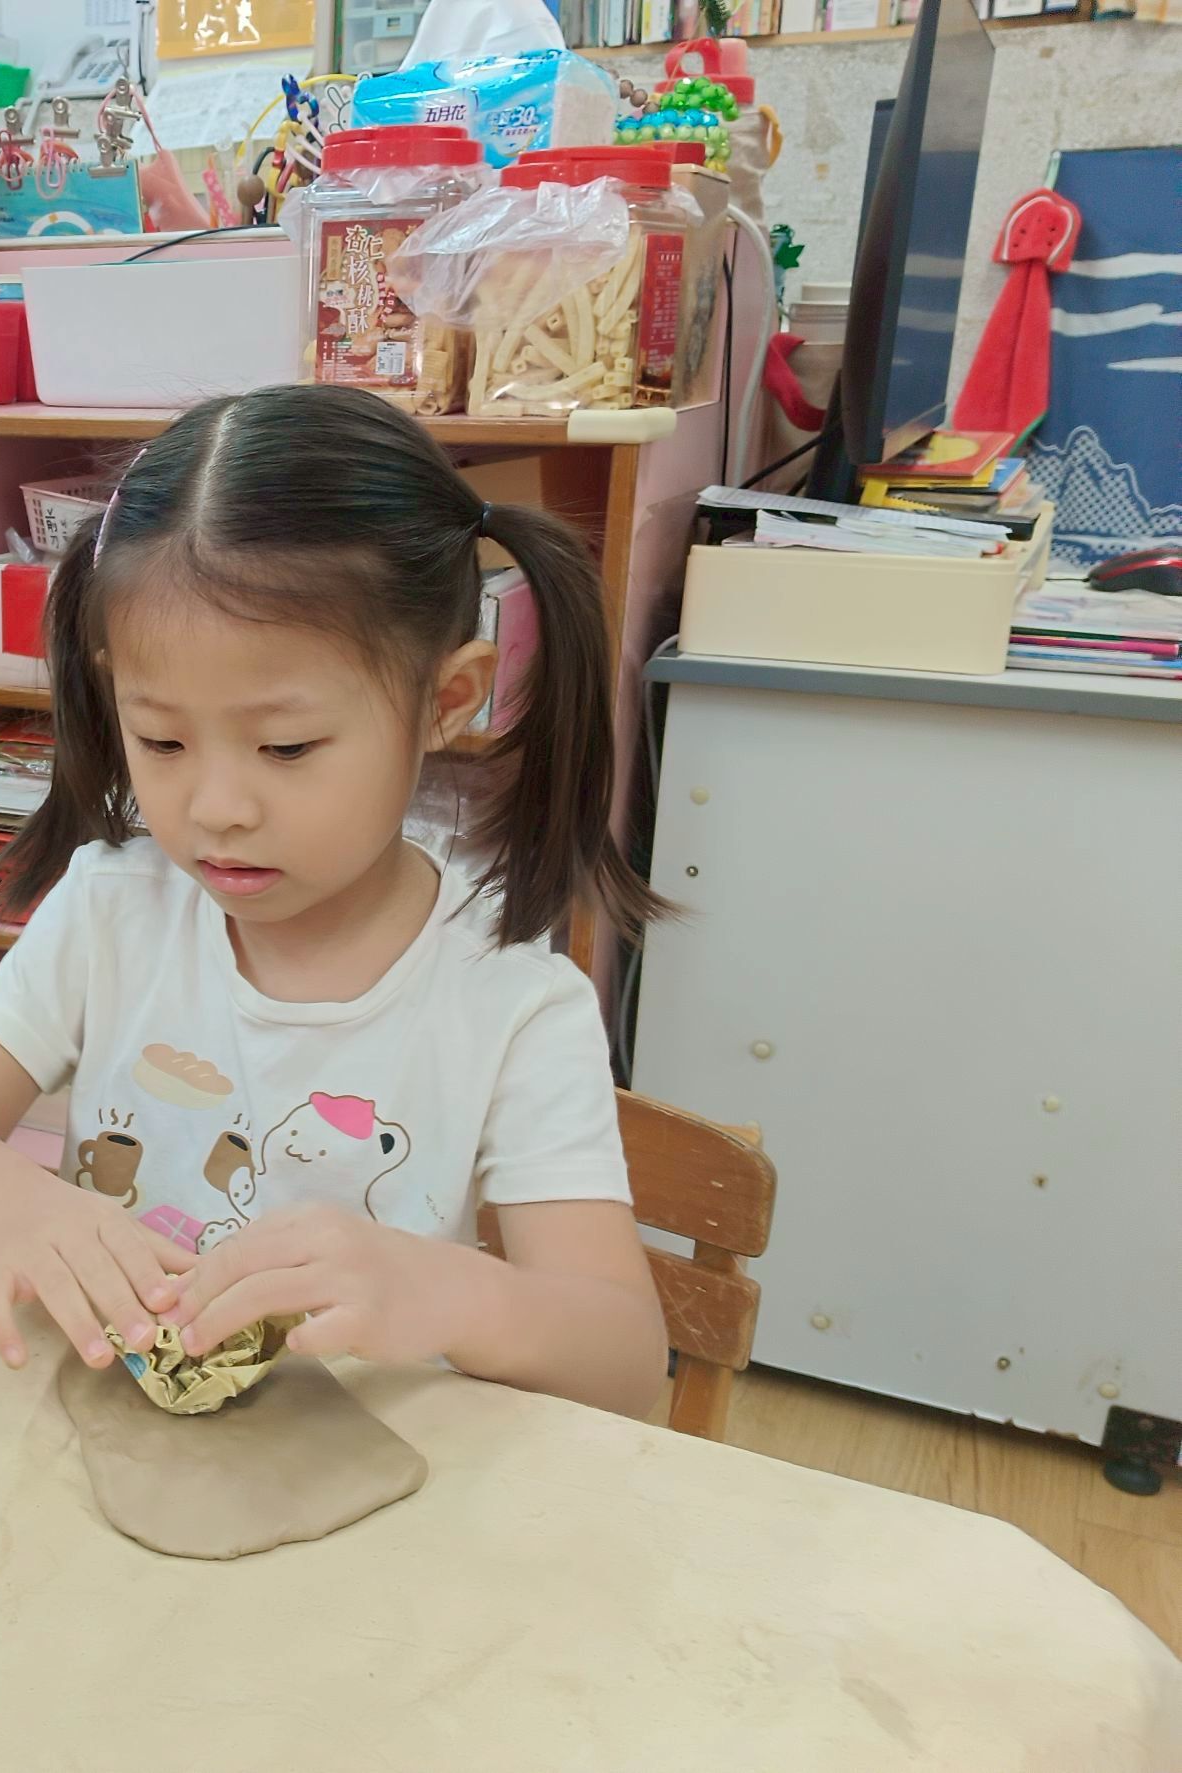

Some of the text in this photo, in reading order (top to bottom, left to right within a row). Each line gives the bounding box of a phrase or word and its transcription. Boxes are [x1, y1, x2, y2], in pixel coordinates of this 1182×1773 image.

[424, 103, 466, 123] 五月花
[345, 225, 384, 335] 杏仁核桃酥
